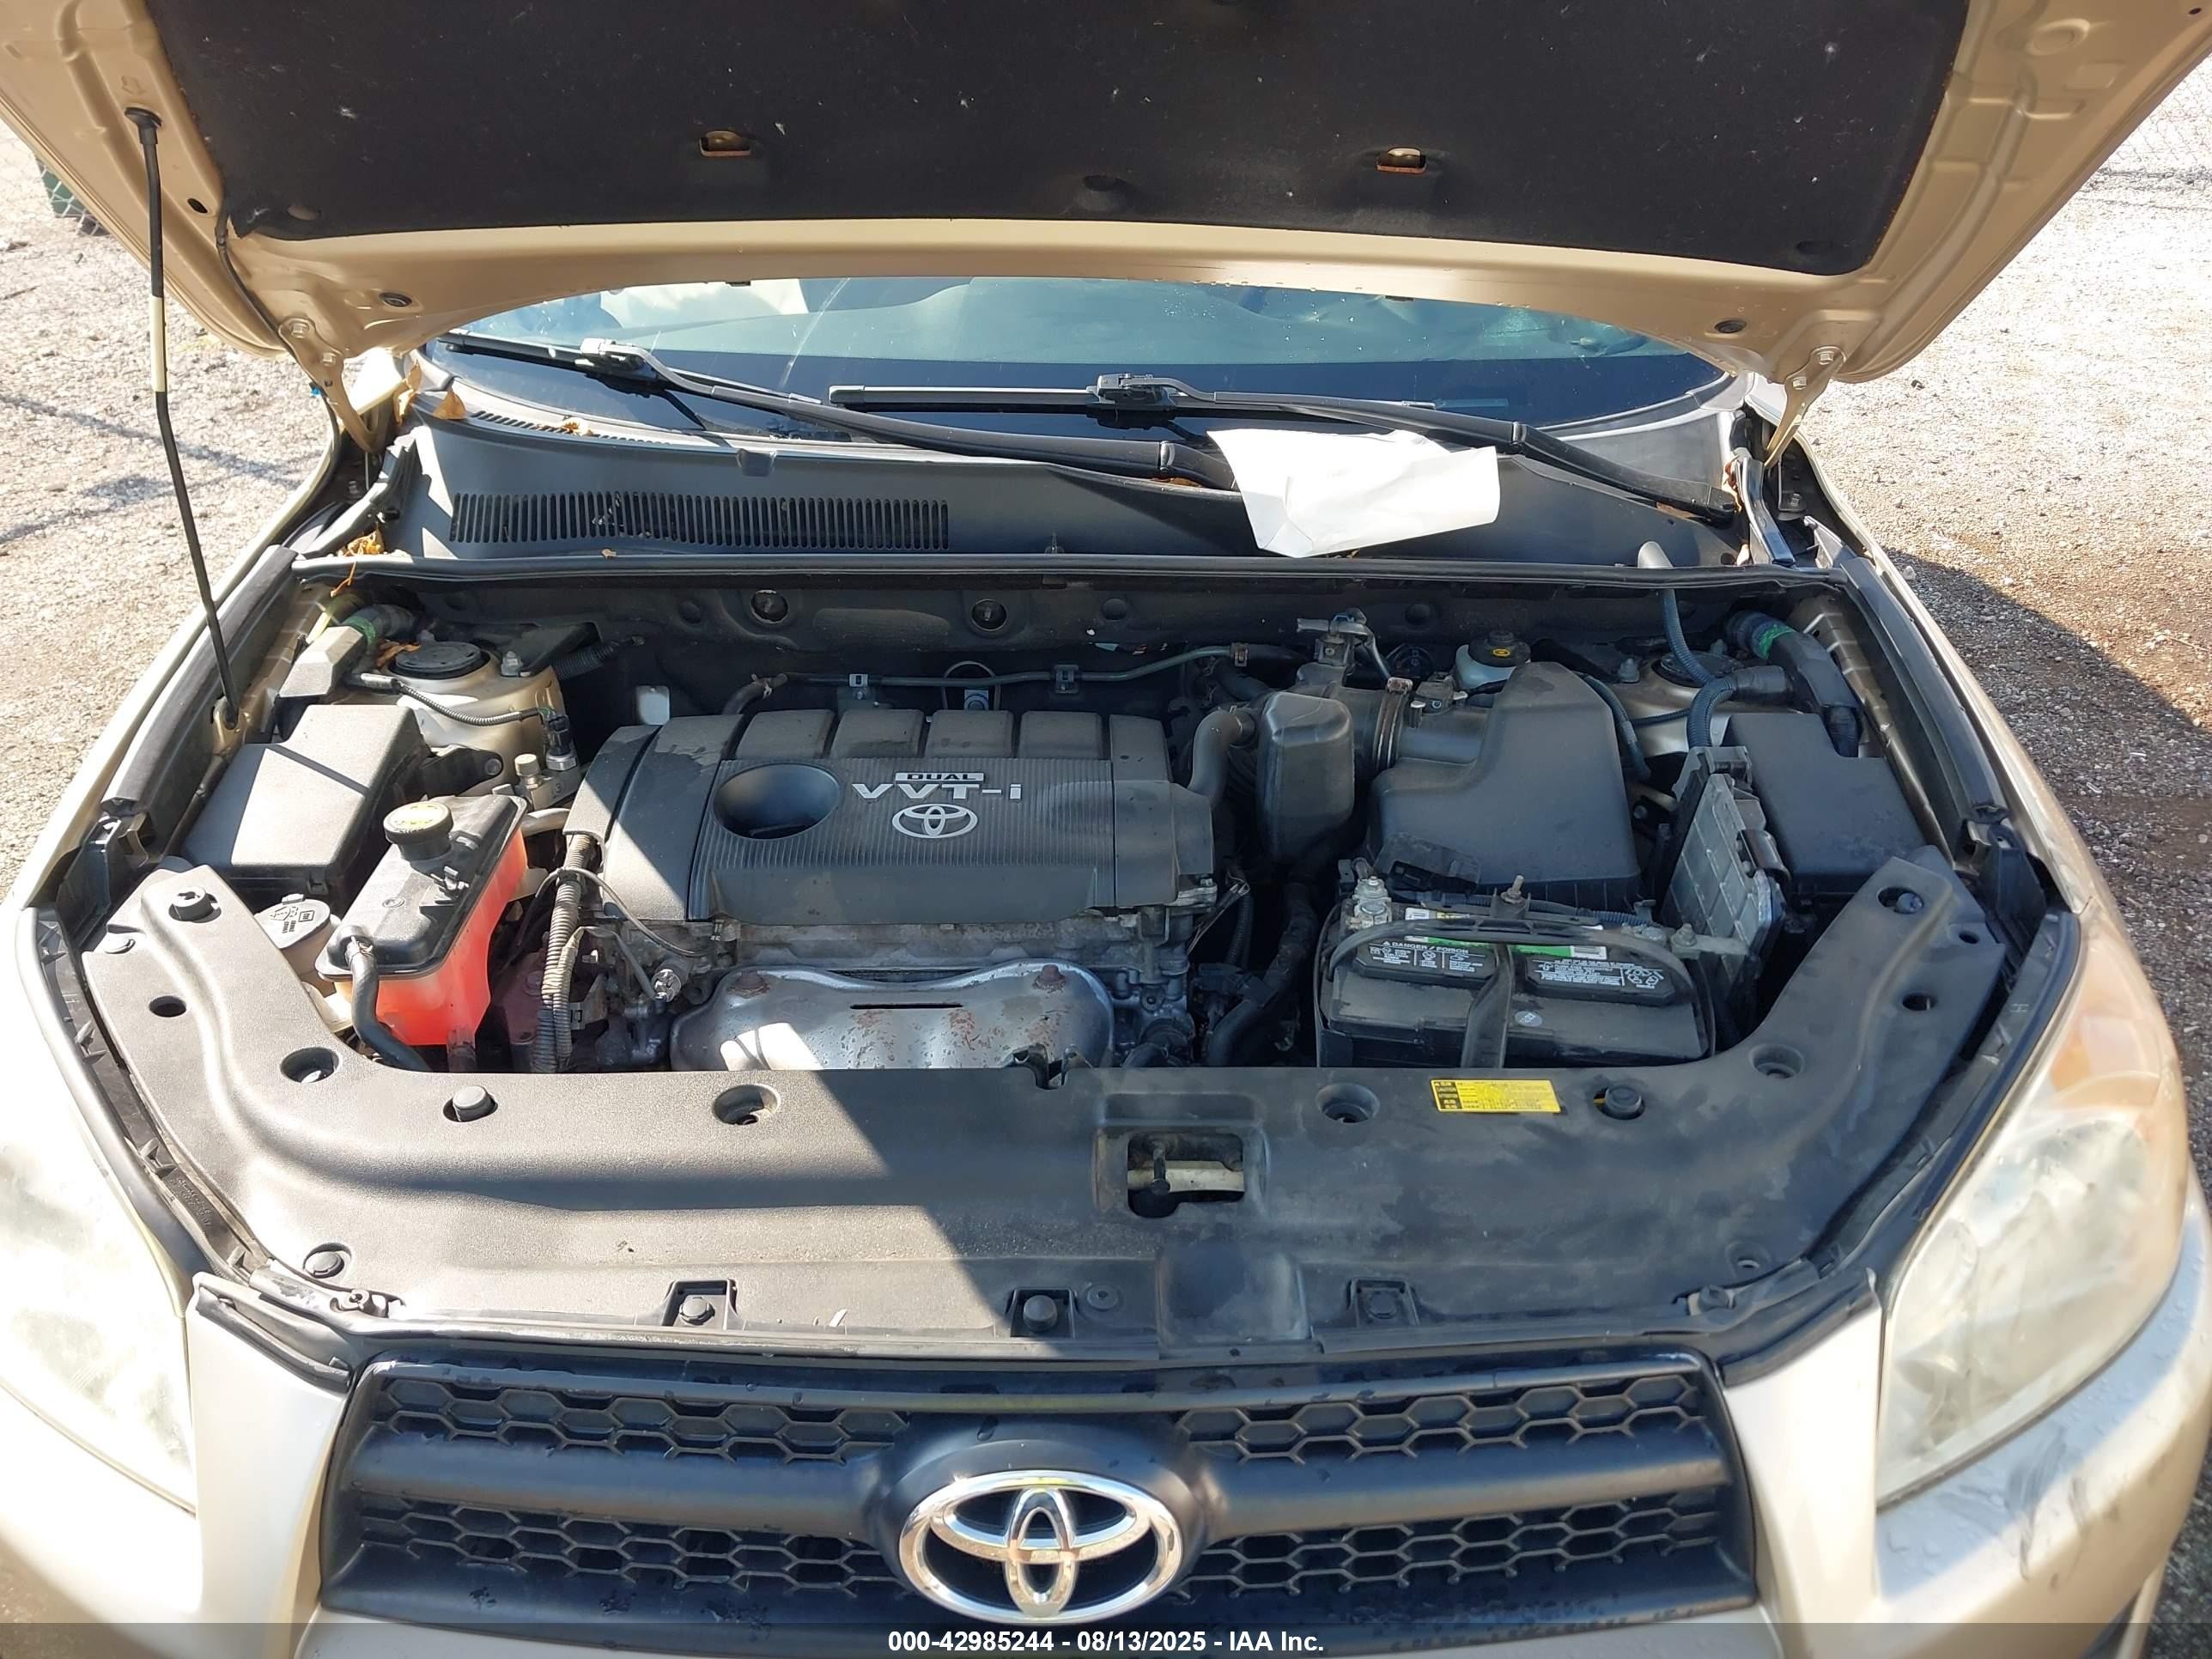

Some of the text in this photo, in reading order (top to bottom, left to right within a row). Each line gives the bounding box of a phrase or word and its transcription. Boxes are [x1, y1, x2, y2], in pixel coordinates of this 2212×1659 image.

[907, 773, 977, 781] DUAL
[852, 783, 1023, 799] VVT-i
[1391, 941, 1428, 951] DANGER
